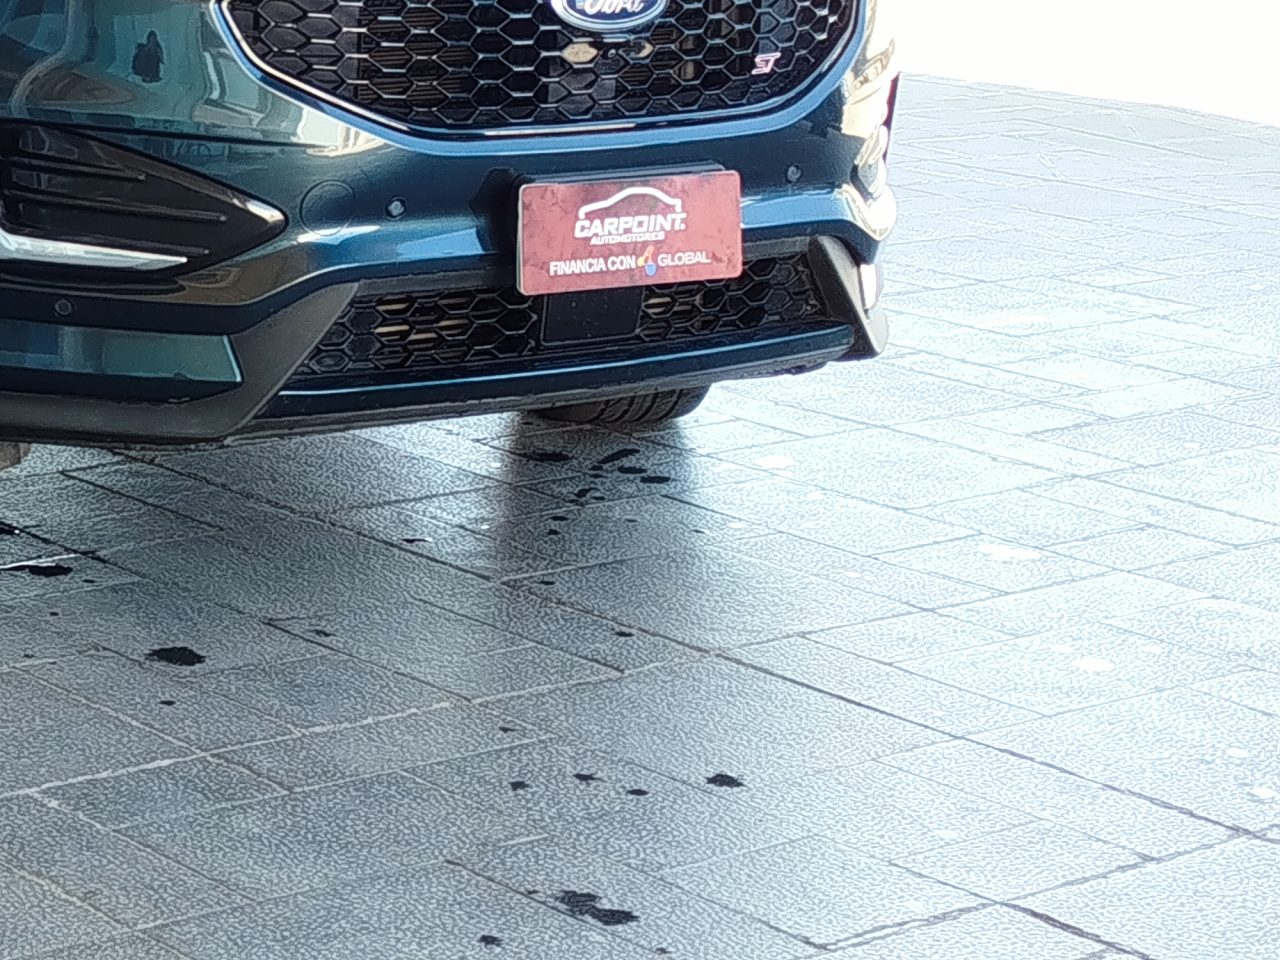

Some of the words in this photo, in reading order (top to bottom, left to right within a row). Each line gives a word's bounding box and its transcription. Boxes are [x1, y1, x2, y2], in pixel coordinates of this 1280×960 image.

[751, 51, 781, 75] ST
[549, 257, 607, 276] FINANCIA
[608, 255, 637, 270] CON
[657, 251, 711, 266] GLOBAL
